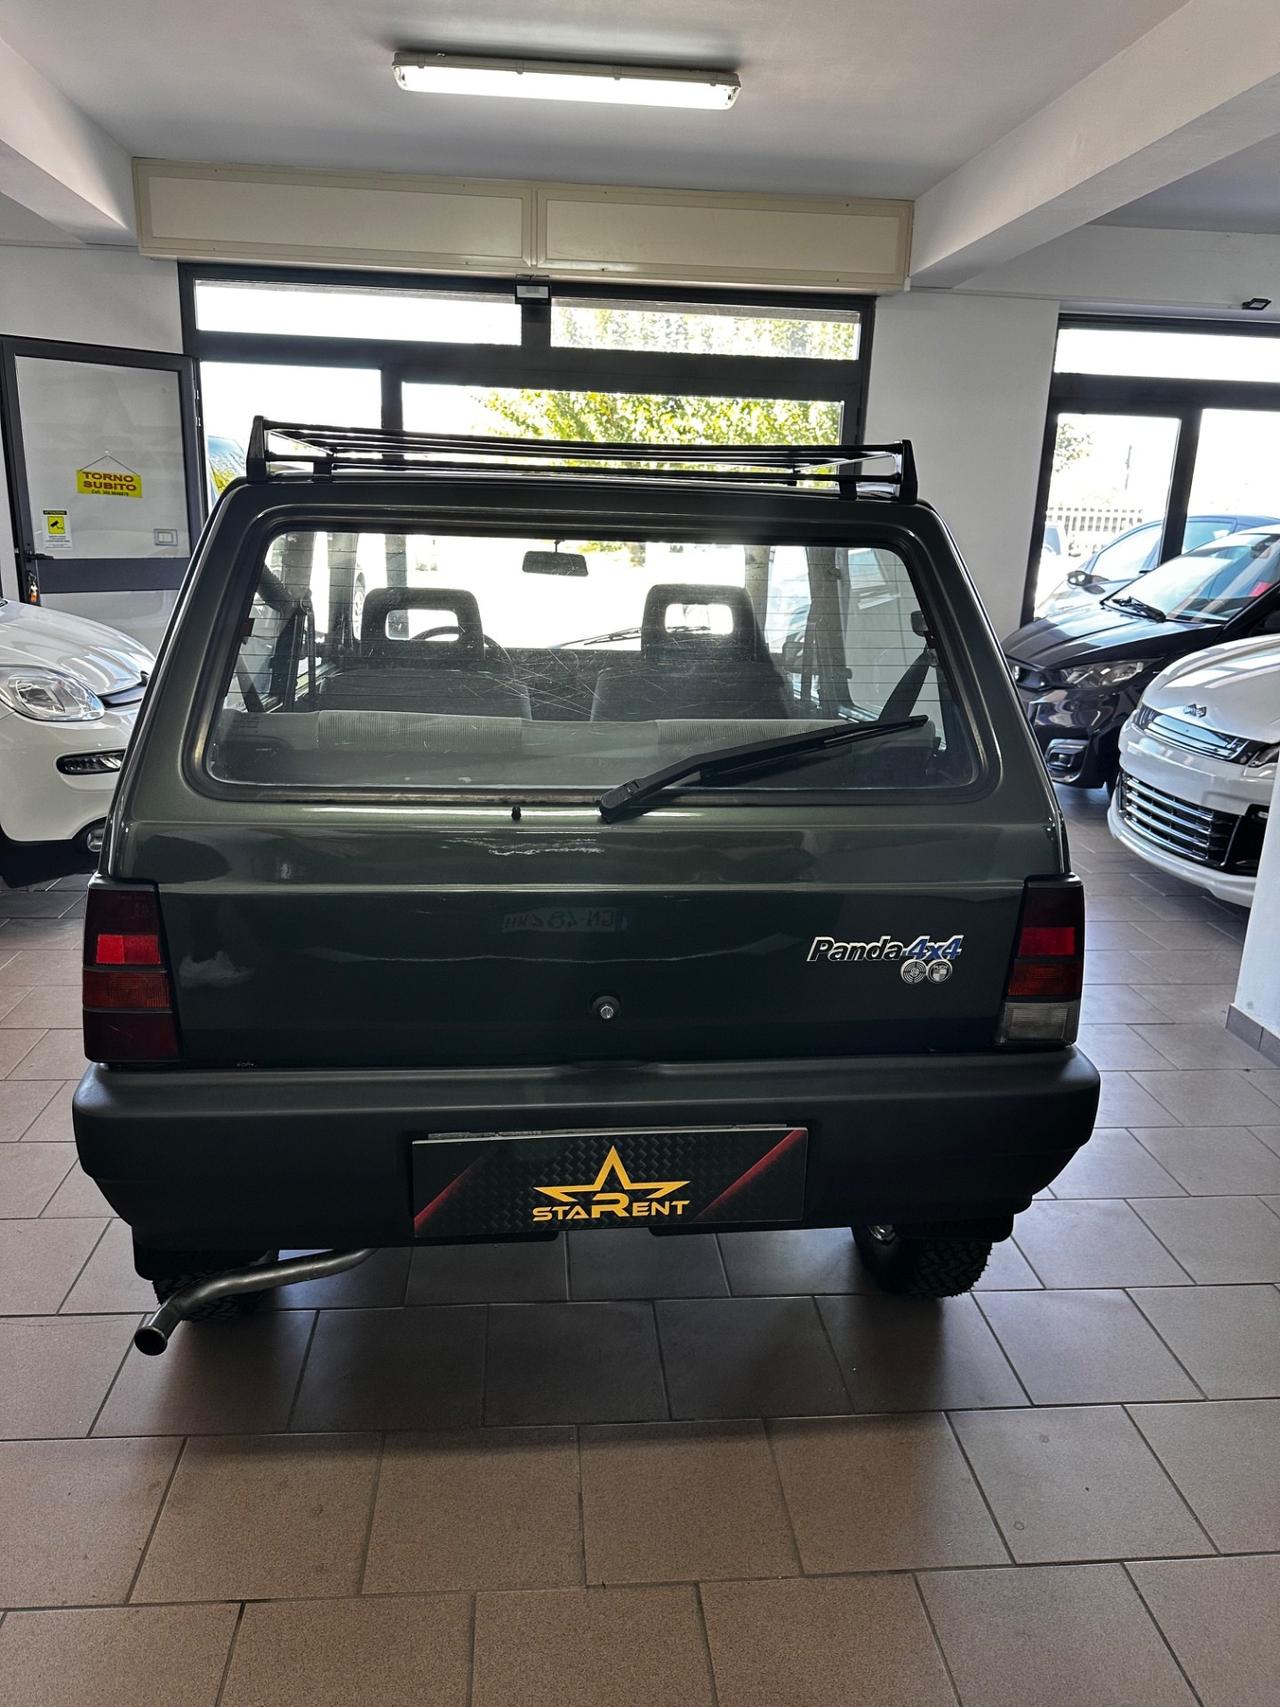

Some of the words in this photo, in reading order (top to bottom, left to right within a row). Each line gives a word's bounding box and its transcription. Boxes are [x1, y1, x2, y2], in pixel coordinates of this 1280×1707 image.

[82, 471, 134, 483] TORNO
[83, 480, 137, 491] SUBITO
[806, 935, 903, 962] Panda
[903, 934, 965, 961] 4x4
